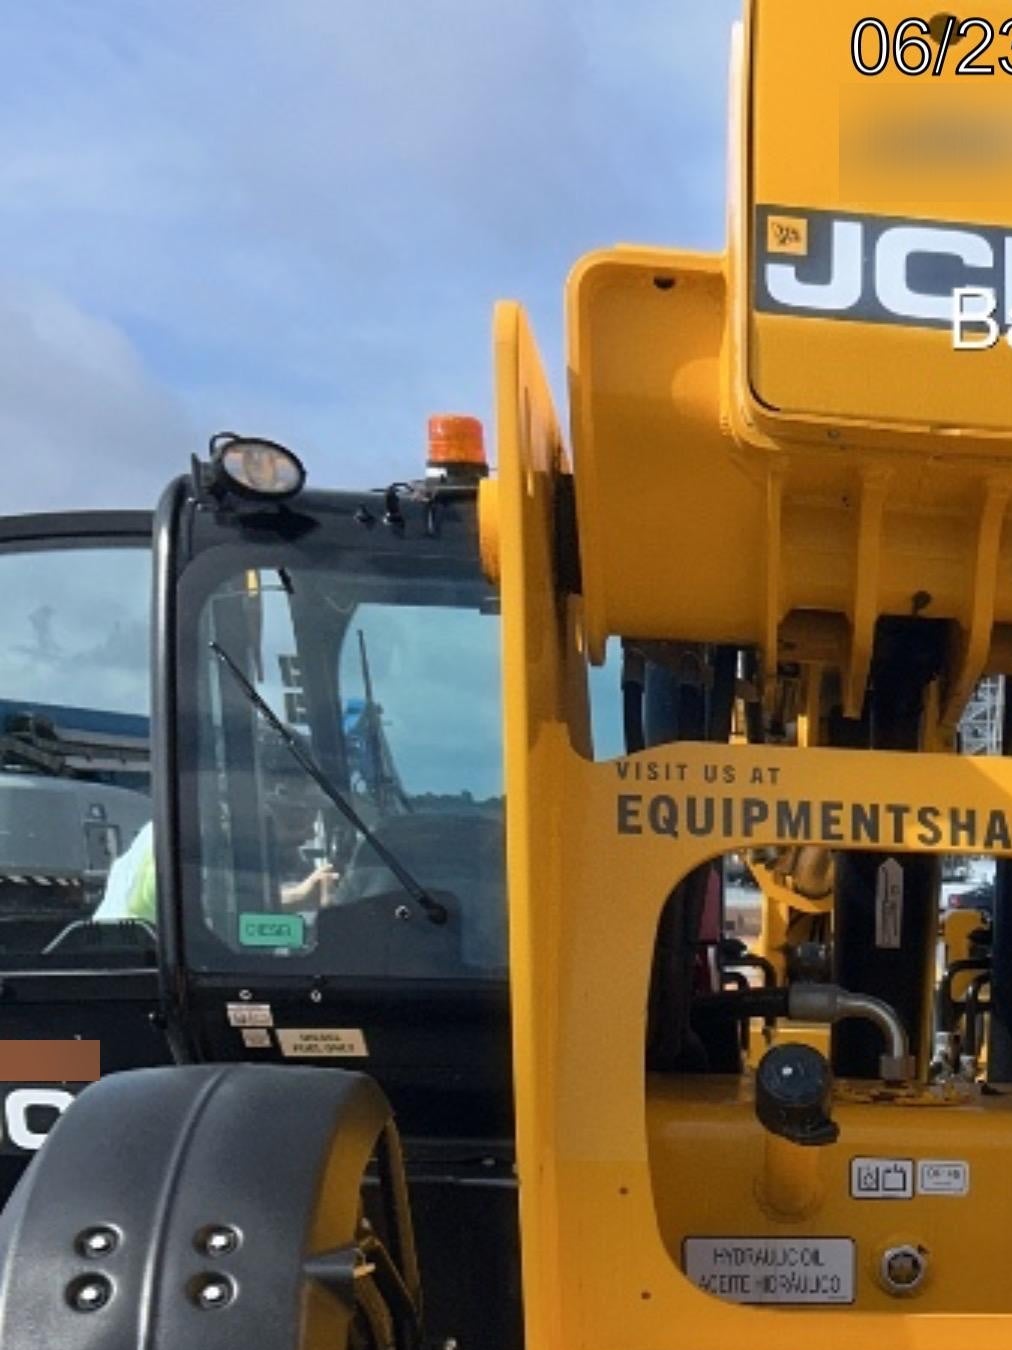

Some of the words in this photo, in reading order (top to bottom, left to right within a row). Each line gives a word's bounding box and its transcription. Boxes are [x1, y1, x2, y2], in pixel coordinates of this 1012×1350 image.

[615, 761, 688, 783] VISIT
[704, 764, 735, 784] US
[749, 766, 782, 785] AT
[713, 1247, 799, 1267] HYDRAULIC
[801, 1247, 825, 1267] OIL
